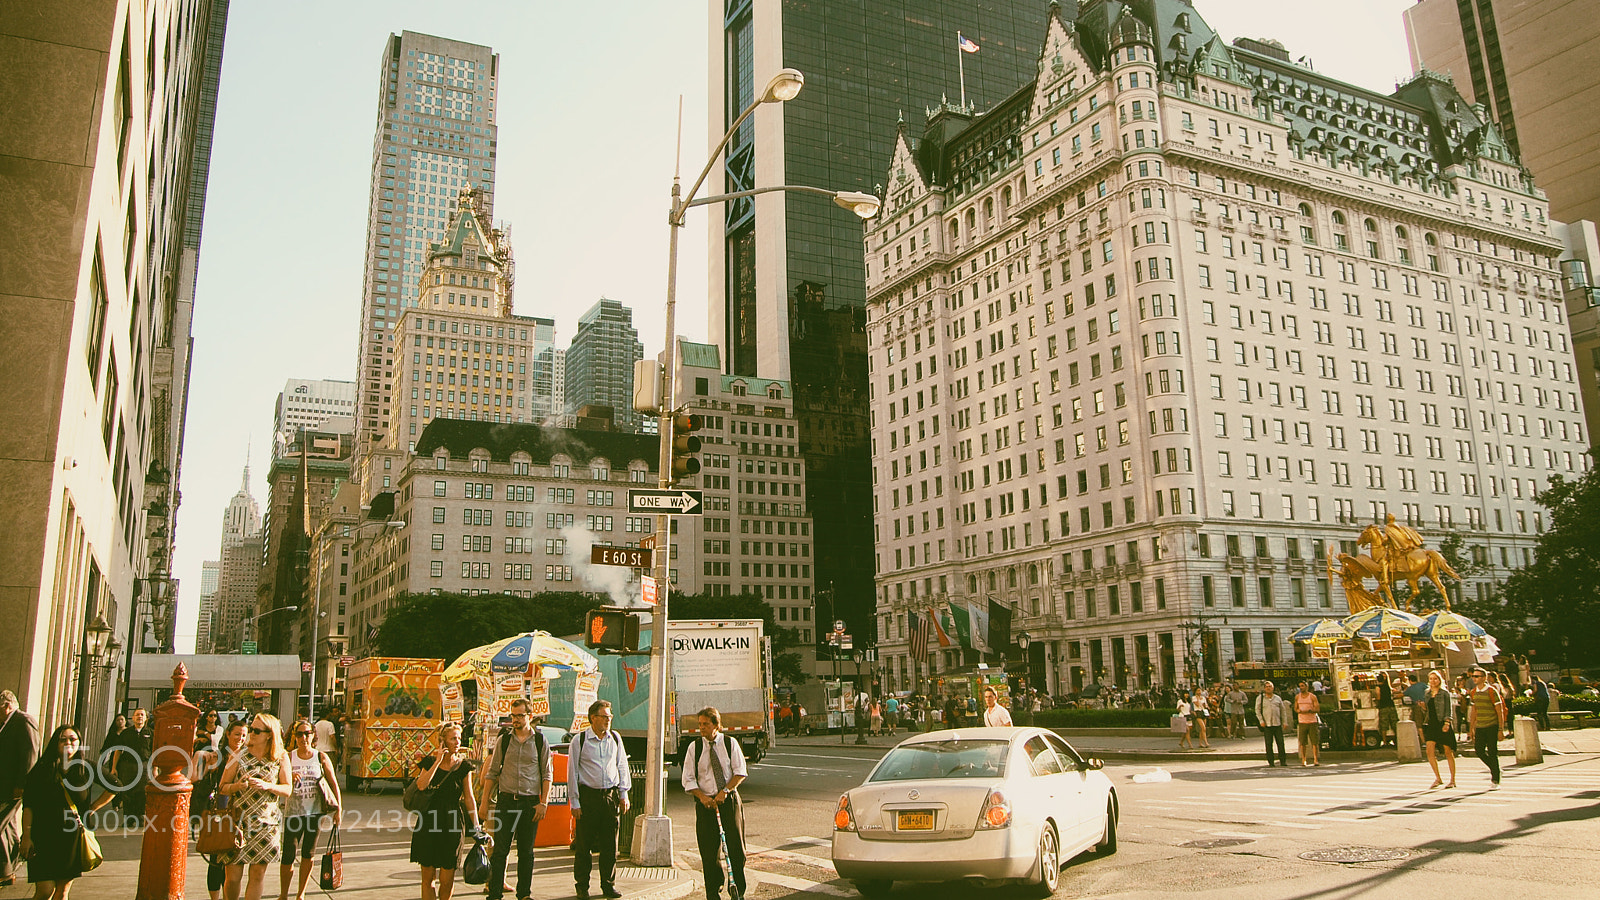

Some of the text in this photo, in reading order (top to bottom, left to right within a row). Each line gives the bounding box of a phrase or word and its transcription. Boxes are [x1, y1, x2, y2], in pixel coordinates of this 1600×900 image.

[640, 497, 692, 507] ONE WAY
[603, 551, 642, 566] E 60 St
[691, 637, 750, 650] WALK-IN
[393, 664, 420, 673] Healthy
[1297, 669, 1312, 677] NEW
